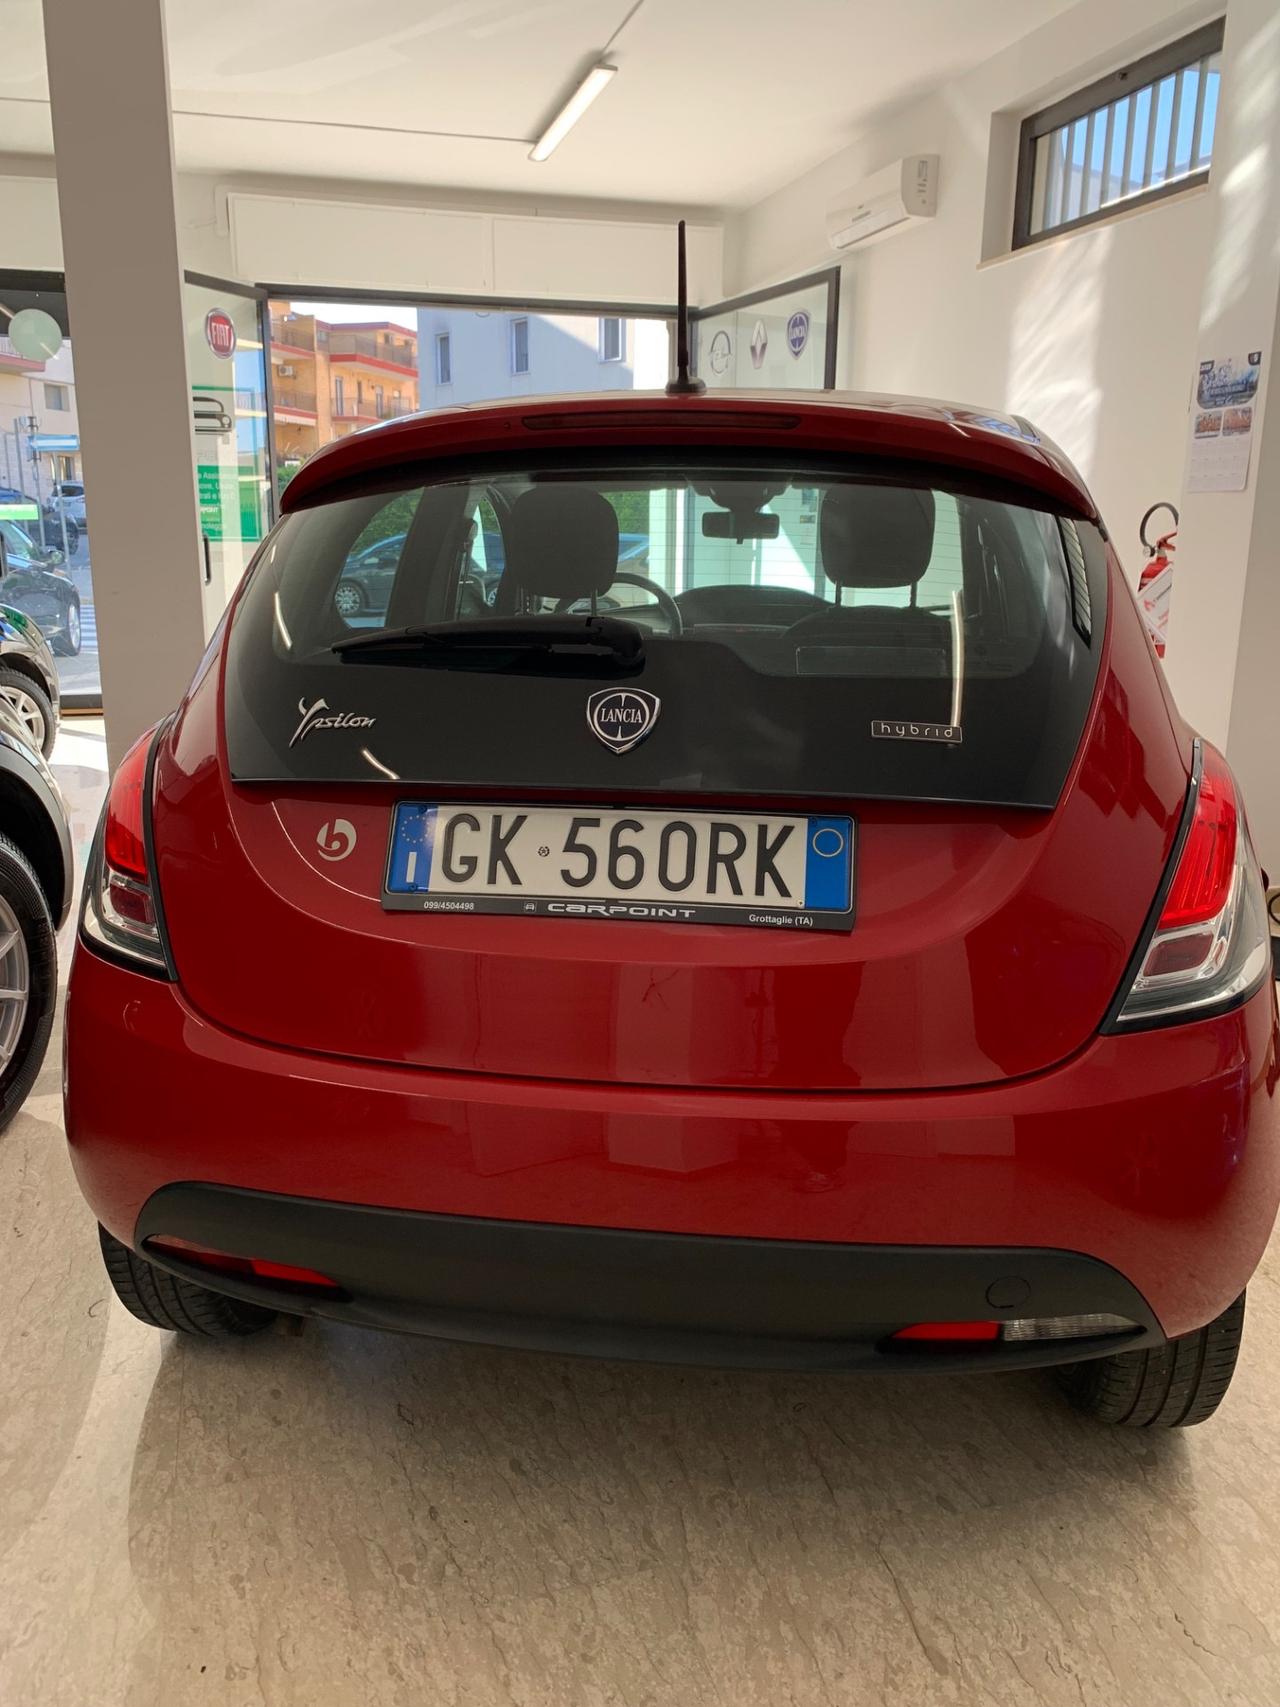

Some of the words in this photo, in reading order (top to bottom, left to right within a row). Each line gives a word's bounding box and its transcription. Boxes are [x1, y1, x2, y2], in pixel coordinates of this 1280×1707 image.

[211, 322, 230, 346] FIAT
[289, 697, 377, 748] Ypsilon
[600, 708, 643, 724] LANCIA
[881, 722, 953, 738] hybrid
[441, 813, 529, 886] GK
[560, 817, 795, 898] 560RK
[423, 901, 475, 910] 099/4504498
[748, 914, 793, 926] Grottaglie
[794, 916, 814, 927] (TA)
